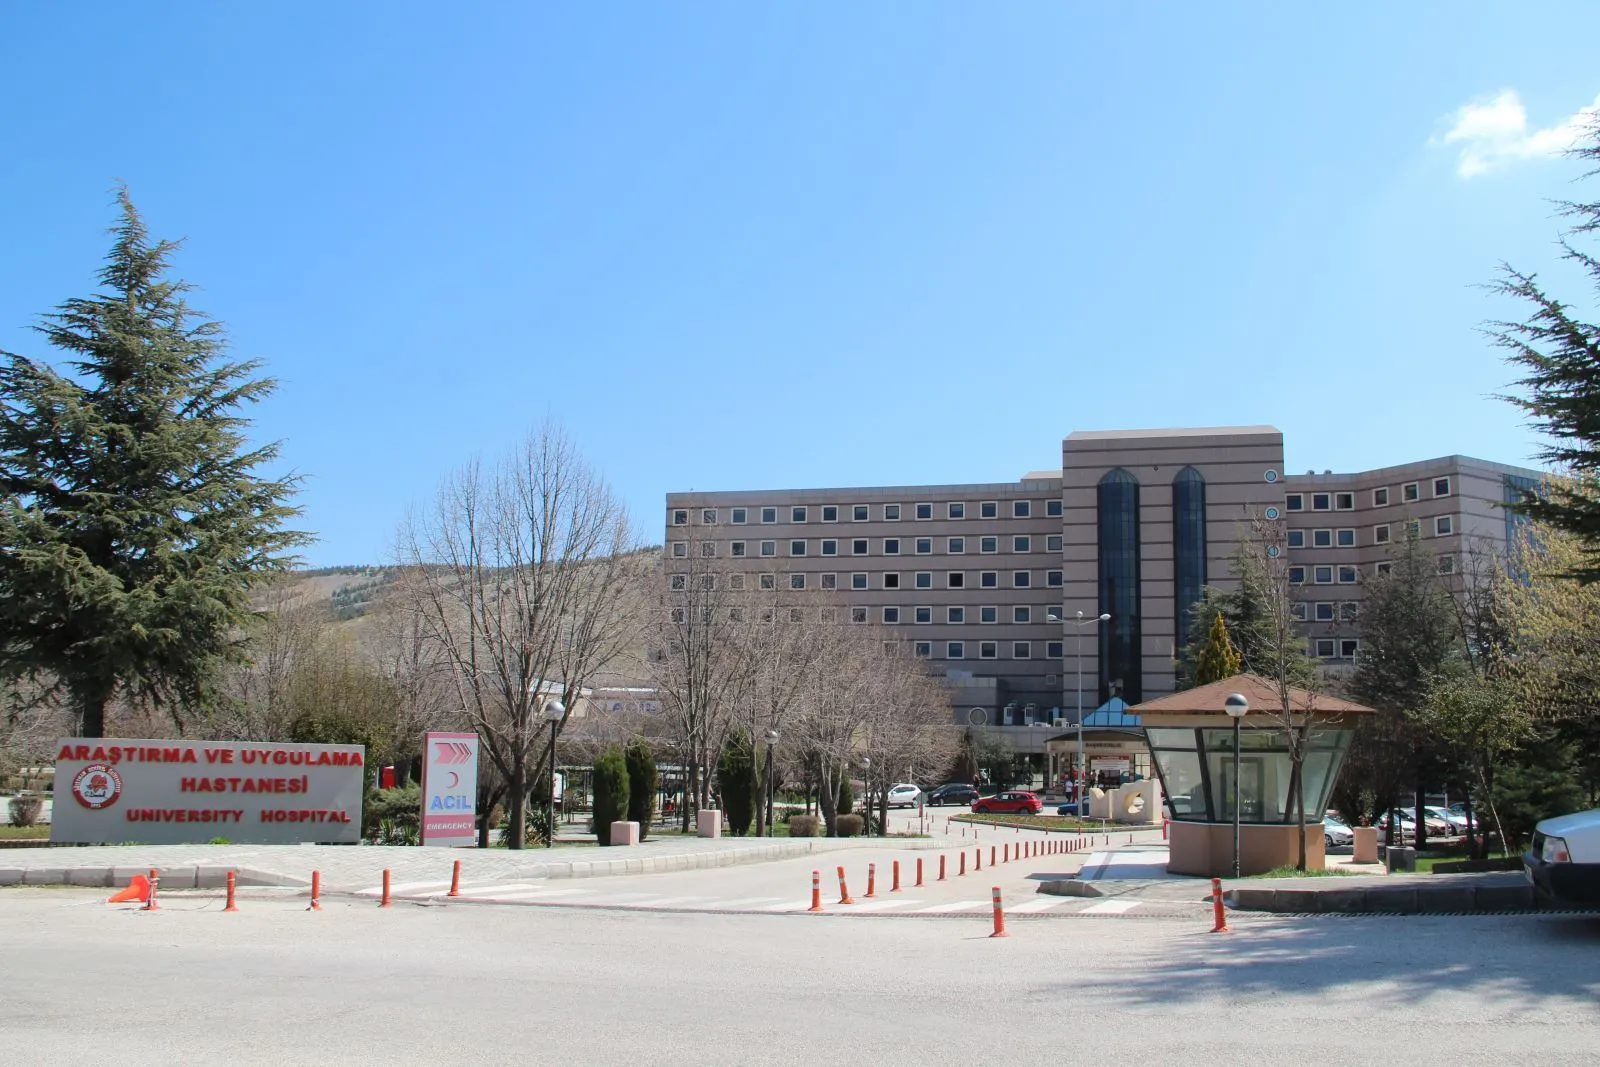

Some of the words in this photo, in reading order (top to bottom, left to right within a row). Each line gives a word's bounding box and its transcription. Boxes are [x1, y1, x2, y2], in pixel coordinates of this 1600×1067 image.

[57, 745, 197, 765] ARAŞTIRMA
[204, 749, 233, 764] VE
[241, 750, 363, 767] UYGULAMA
[181, 775, 308, 793] HASTANESİ
[126, 809, 244, 823] UNIVERSITY
[261, 810, 351, 823] HOSPITAL
